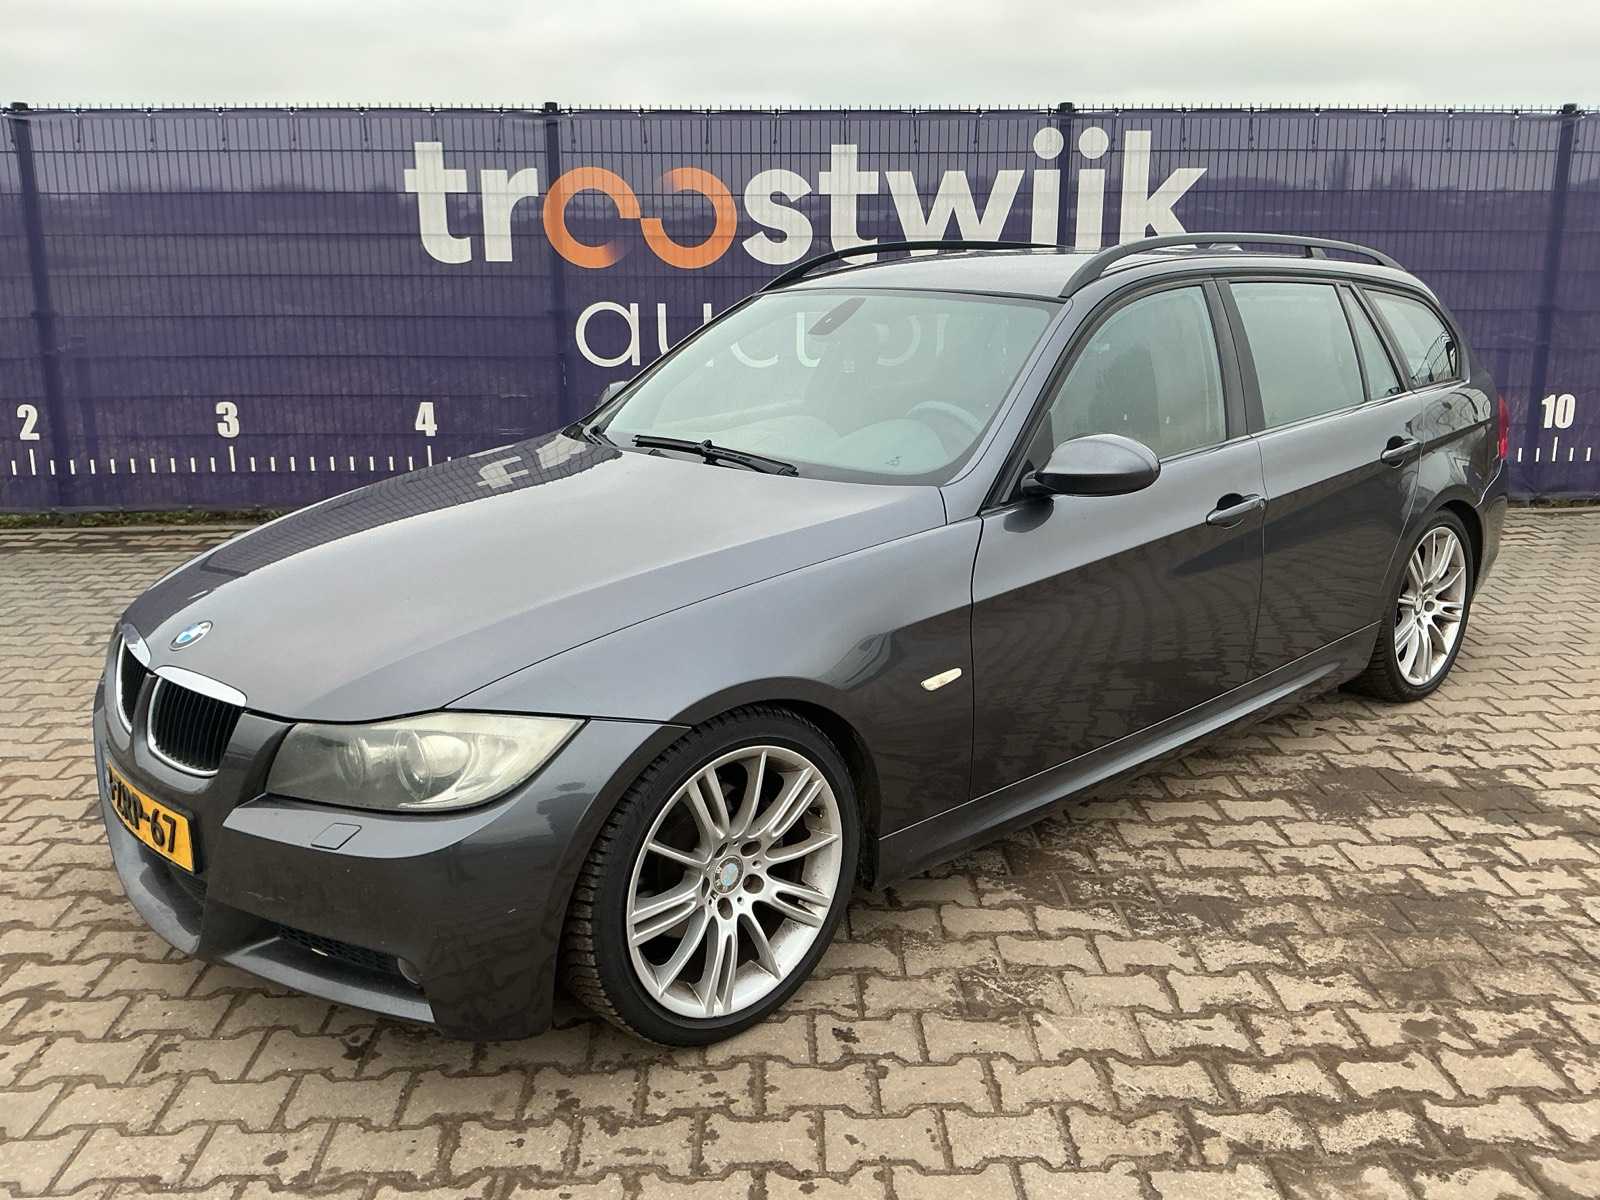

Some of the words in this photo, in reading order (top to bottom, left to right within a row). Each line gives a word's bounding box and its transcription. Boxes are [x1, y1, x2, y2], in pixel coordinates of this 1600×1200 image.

[17, 404, 40, 440] 2
[216, 402, 240, 438] 3
[415, 402, 438, 436] 4
[1541, 393, 1576, 429] 10
